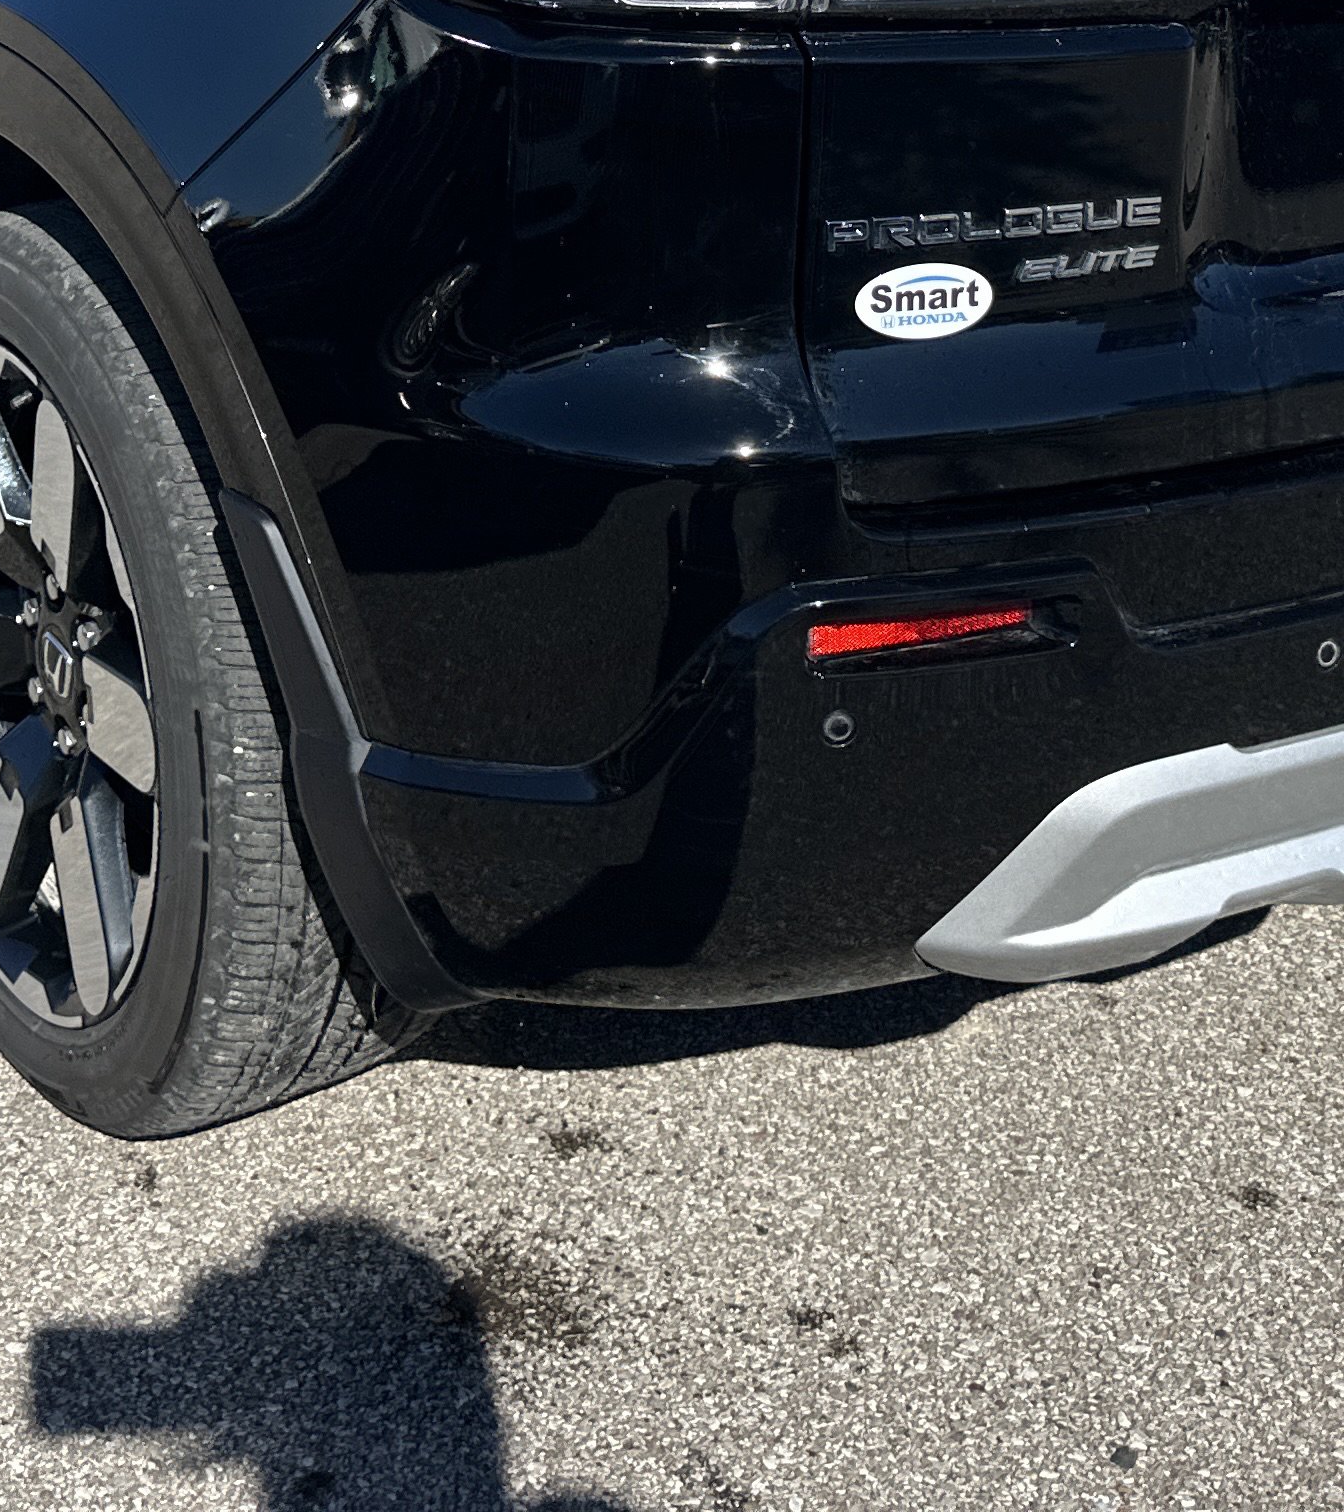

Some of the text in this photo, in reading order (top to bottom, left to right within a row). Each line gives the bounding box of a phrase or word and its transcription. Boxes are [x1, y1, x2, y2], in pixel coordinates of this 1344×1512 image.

[824, 195, 1163, 253] PROLOGUE
[1014, 244, 1161, 284] ELITE
[869, 278, 980, 314] Smart
[898, 311, 969, 327] HONDA
